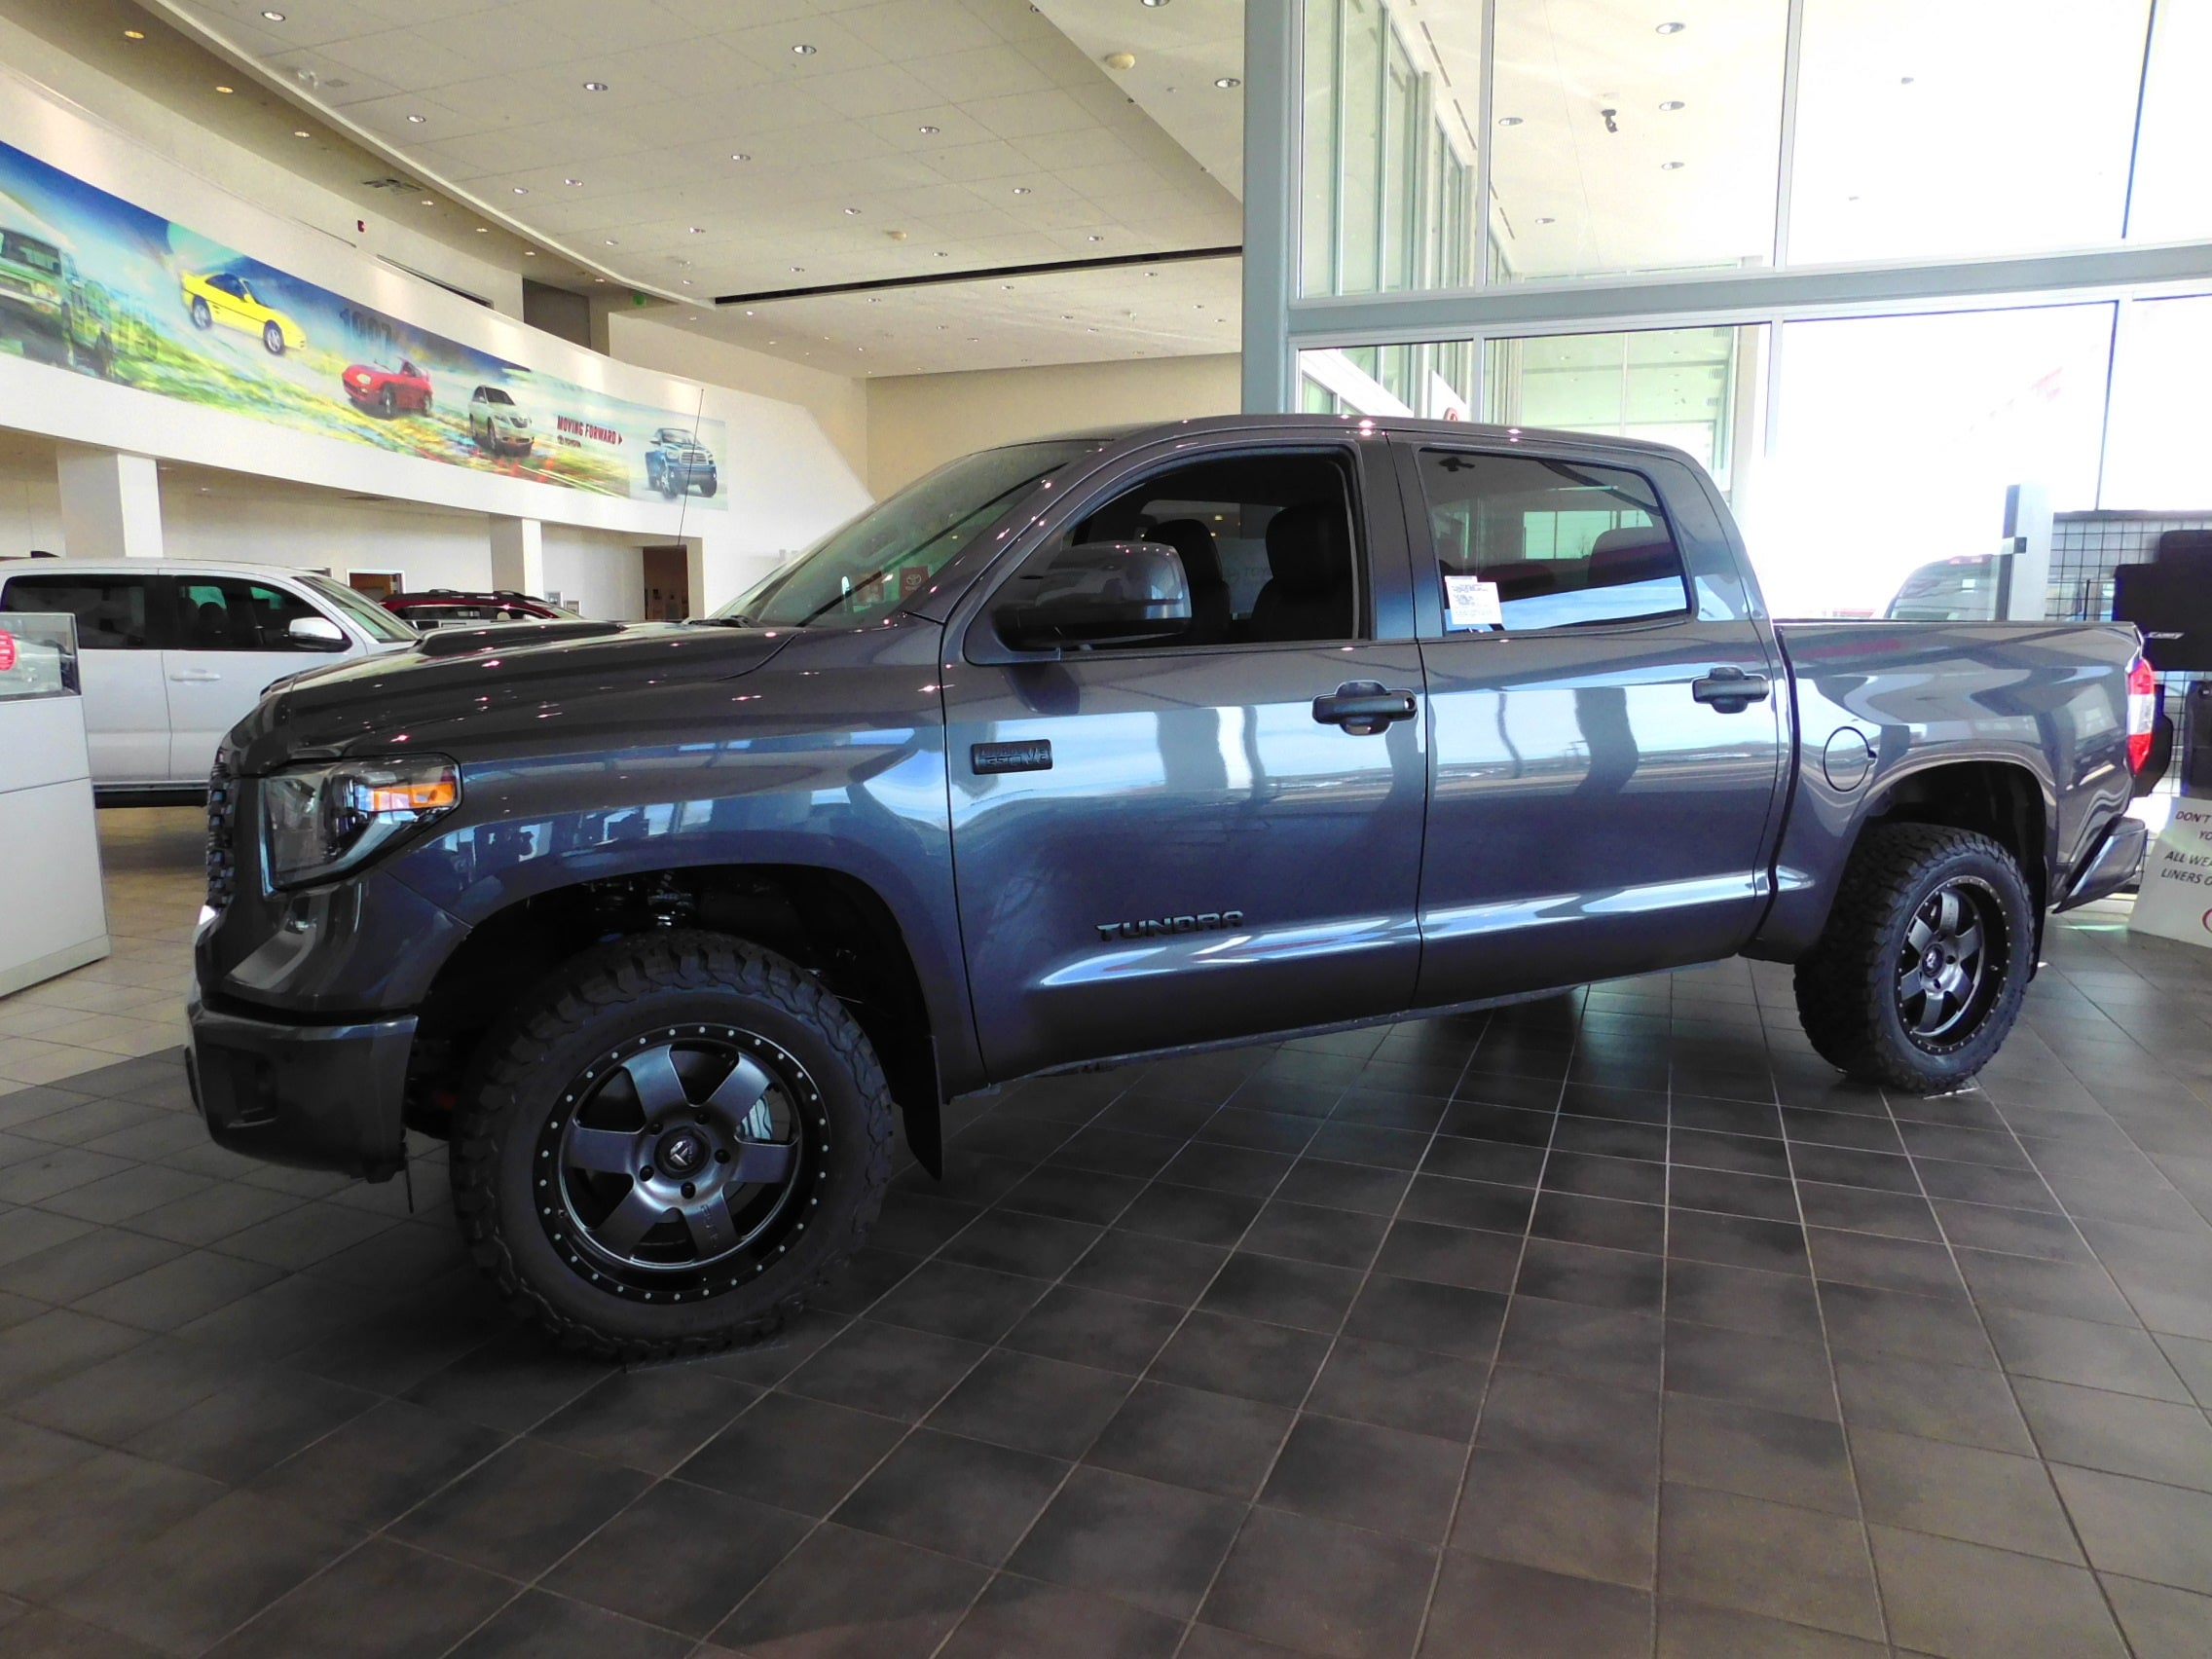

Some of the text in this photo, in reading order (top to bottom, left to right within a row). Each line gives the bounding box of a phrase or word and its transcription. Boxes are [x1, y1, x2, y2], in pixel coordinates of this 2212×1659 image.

[557, 415, 616, 444] MOVING FORWARD
[2175, 810, 2212, 824] DON'T
[2164, 850, 2185, 863] ALL
[2161, 867, 2202, 884] LINERS
[1096, 909, 1243, 941] TUNDRA
